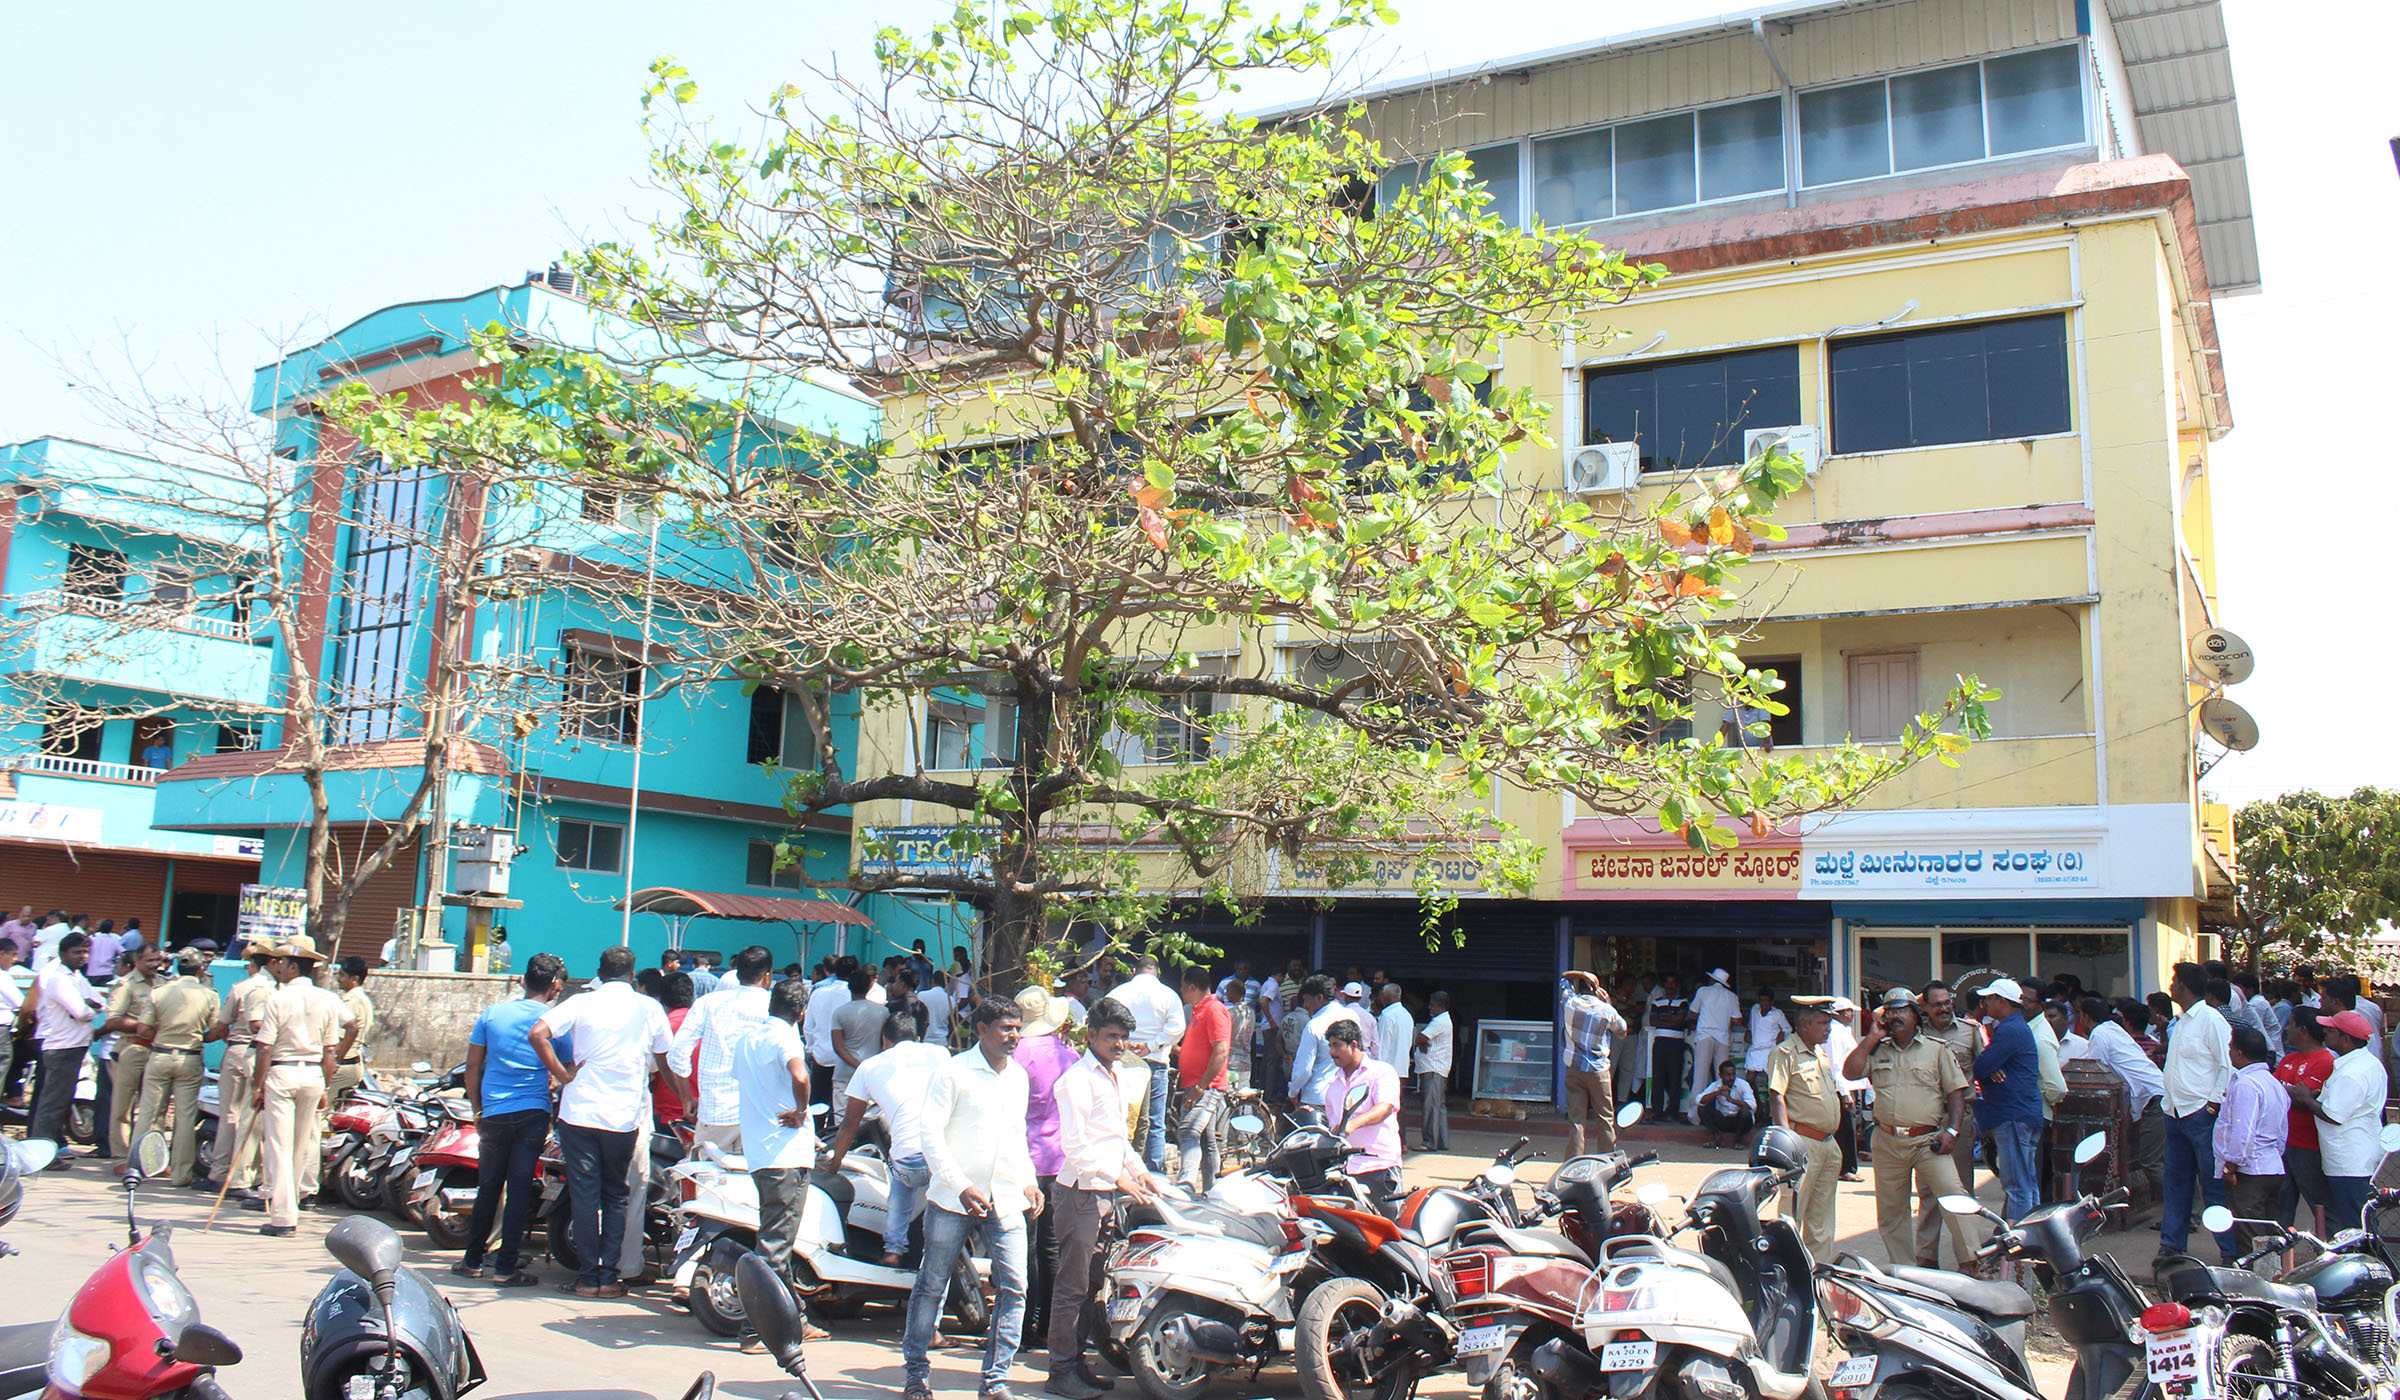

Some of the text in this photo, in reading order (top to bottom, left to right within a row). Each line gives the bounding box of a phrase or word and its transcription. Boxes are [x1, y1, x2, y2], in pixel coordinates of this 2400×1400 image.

[1591, 854, 1655, 879] ಚೇತನಾ
[1659, 853, 1729, 879] ಜನರಲ್
[1815, 850, 1855, 879] ಮಲ್ಪೆ
[1859, 849, 1984, 874] ಮೀನುಗಾರರ
[1992, 849, 2053, 874] ಸಂಘ
[241, 896, 302, 918] M-TECH
[1463, 1339, 1497, 1351] 8565
[2152, 1343, 2191, 1356] KA 20 EM
[1610, 1358, 1645, 1368] 4279
[2149, 1353, 2196, 1375] 1414
[1840, 1373, 1867, 1383] 6910
